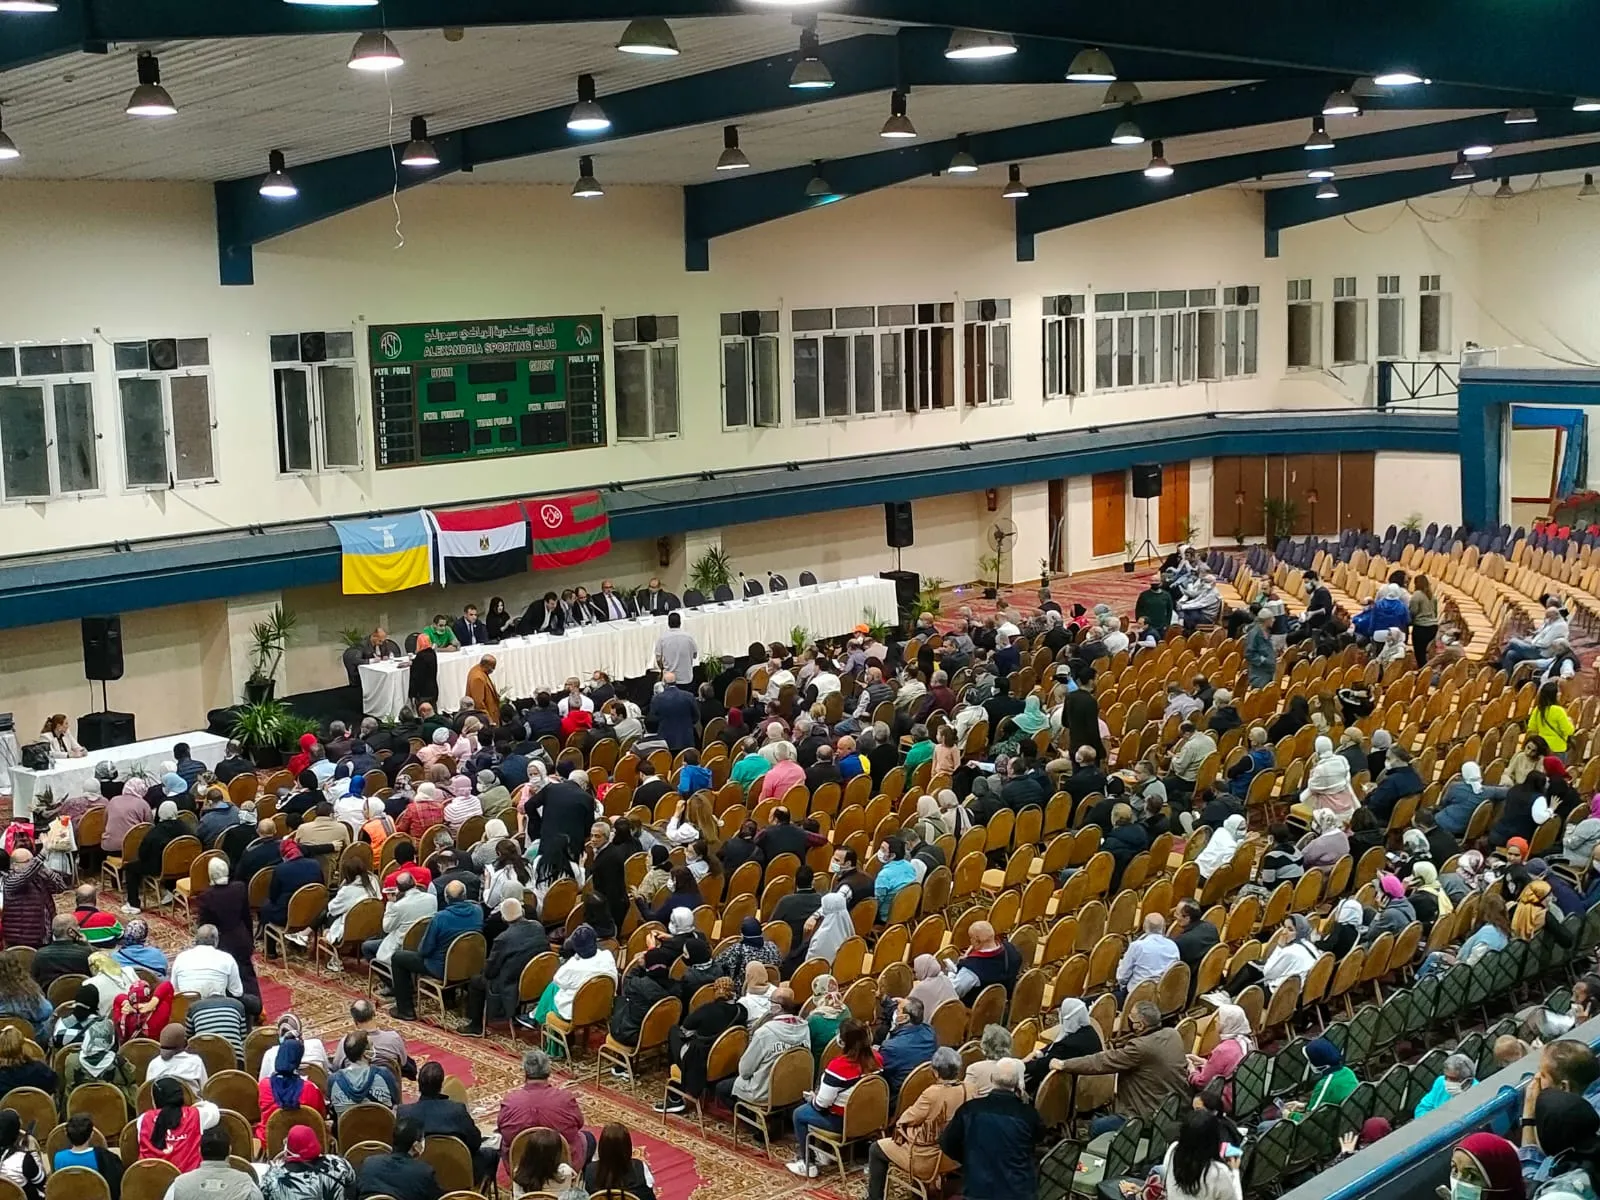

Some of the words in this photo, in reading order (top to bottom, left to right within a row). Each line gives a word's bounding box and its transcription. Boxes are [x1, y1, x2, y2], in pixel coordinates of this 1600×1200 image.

[424, 344, 483, 358] ALEXANDRIA
[484, 340, 532, 354] SPORTING
[532, 339, 557, 350] CLUB
[374, 368, 388, 376] PLYR
[392, 366, 410, 375] FOULS
[529, 360, 554, 372] GUEST
